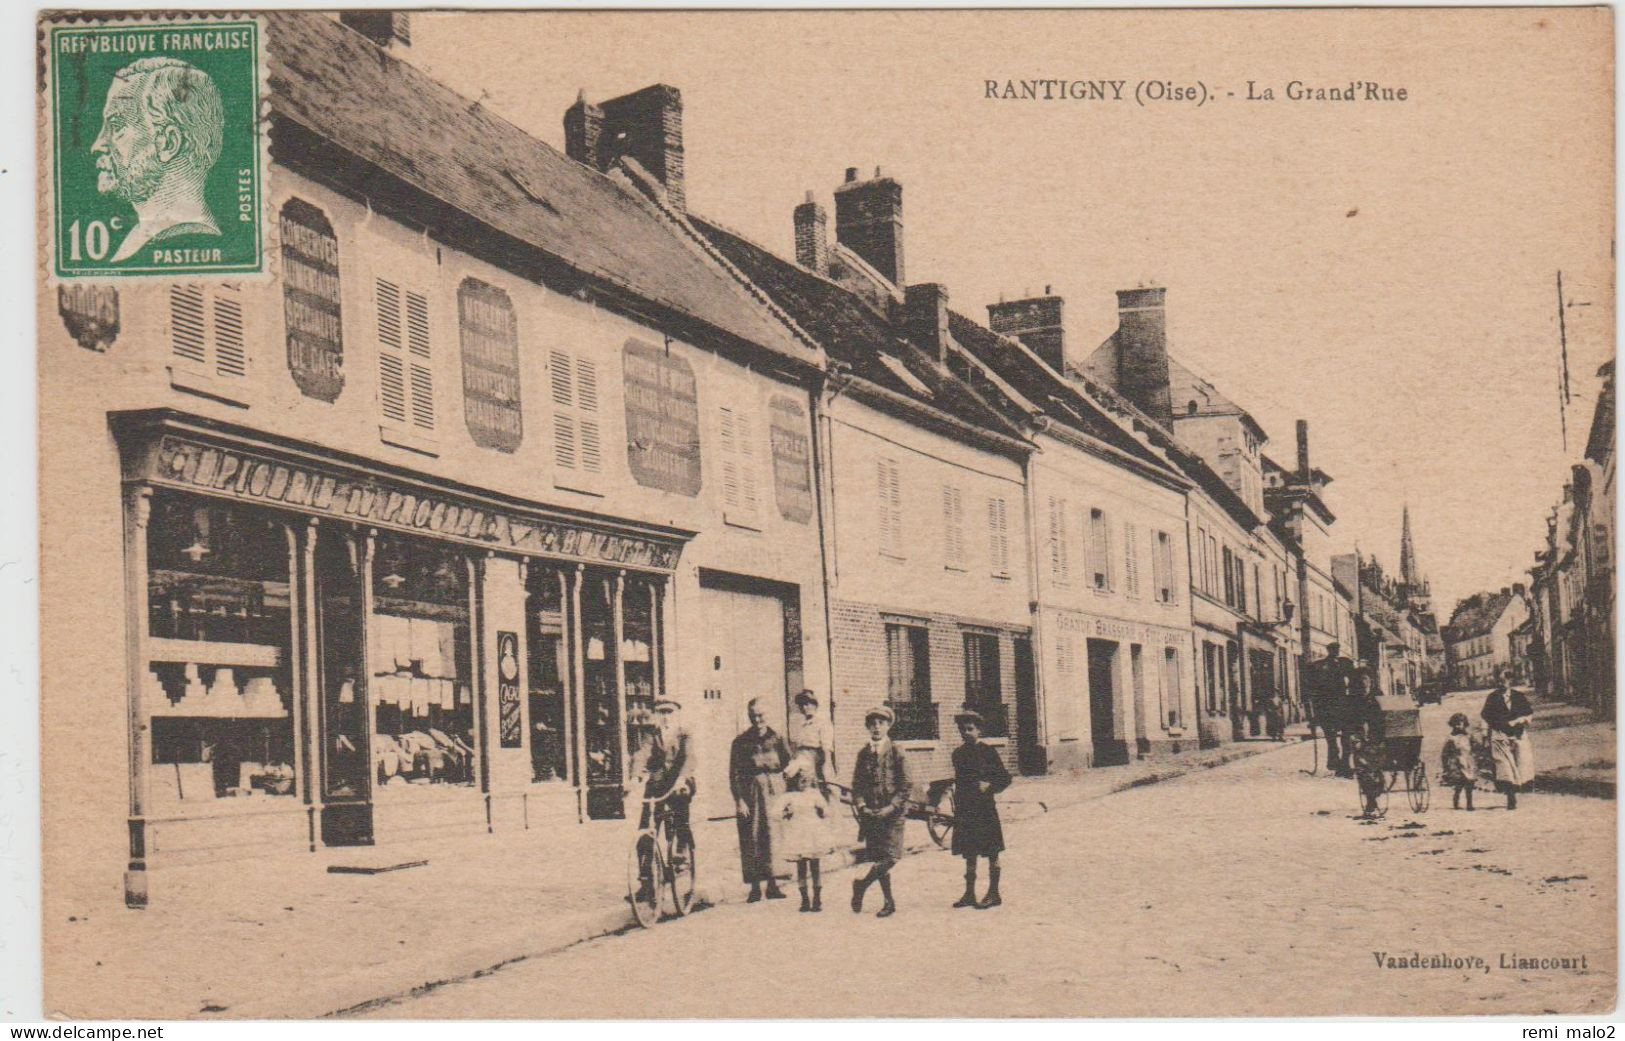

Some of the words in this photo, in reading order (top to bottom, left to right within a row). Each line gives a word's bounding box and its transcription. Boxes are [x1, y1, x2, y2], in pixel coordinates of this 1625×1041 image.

[163, 31, 249, 51] FRANÇAISE
[239, 168, 251, 222] POSTES
[153, 249, 222, 264] PASTEUR
